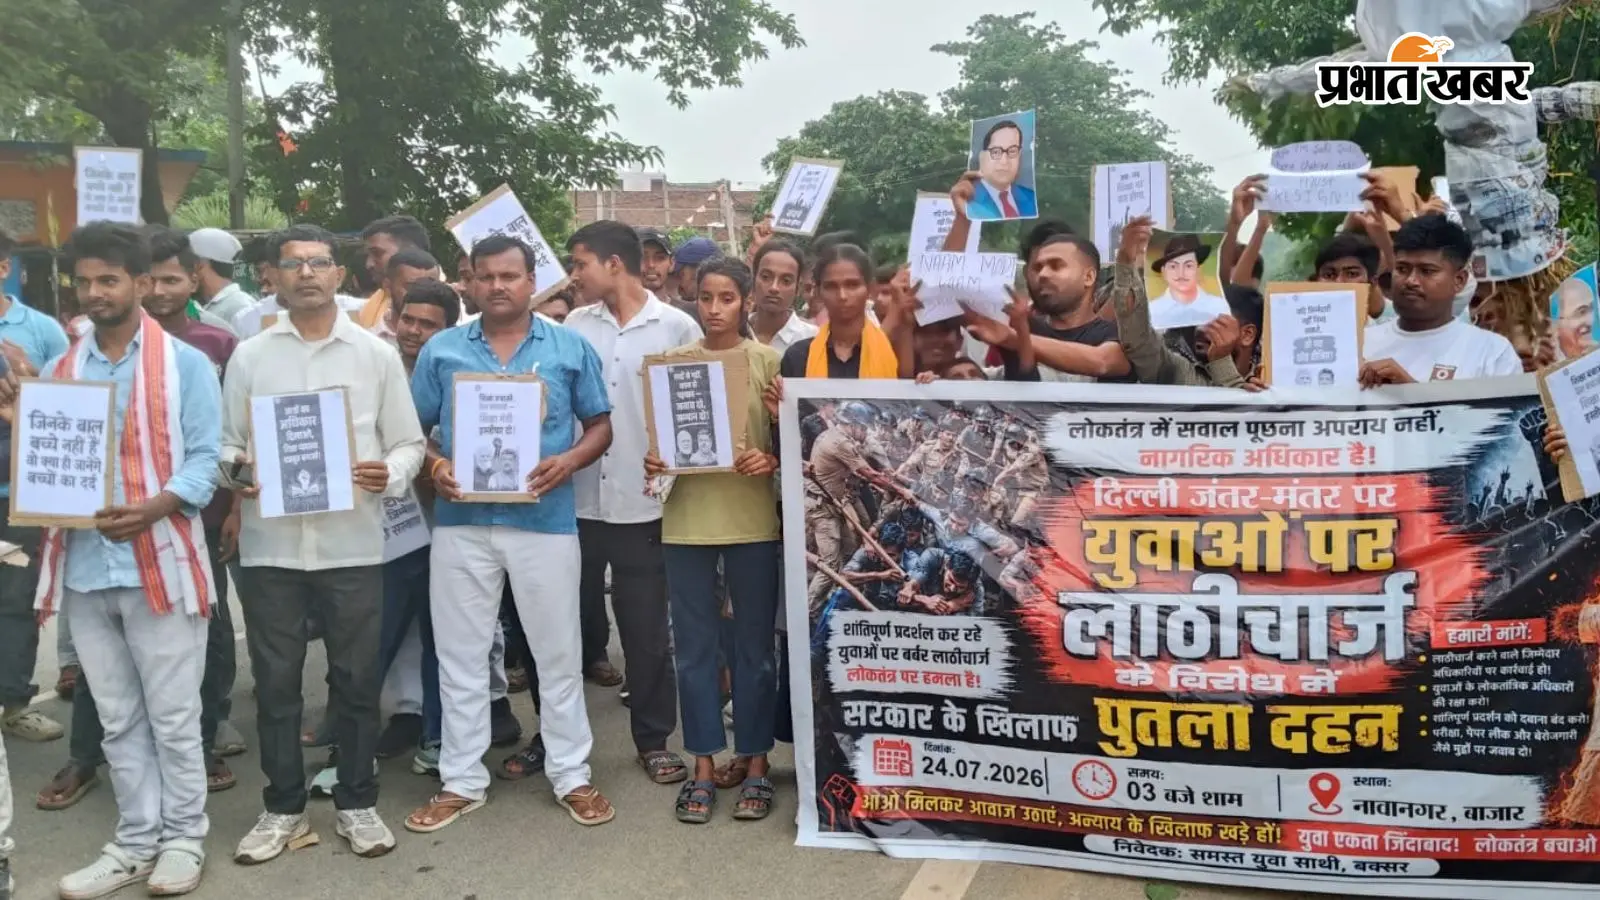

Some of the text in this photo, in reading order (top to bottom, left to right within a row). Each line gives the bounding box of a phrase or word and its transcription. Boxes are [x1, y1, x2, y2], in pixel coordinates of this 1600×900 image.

[26, 409, 104, 435] जिनके बाल
[280, 415, 317, 430] अधिकार
[1068, 417, 1144, 440] लोकतंत्र
[1150, 416, 1174, 438] में
[1176, 420, 1238, 438] सवाल
[1245, 419, 1304, 443] पूछना
[1394, 411, 1445, 434] नहीं,
[29, 433, 58, 450] बच्चे
[1138, 442, 1376, 469] नागरिक अधिकार है!
[60, 474, 76, 488] का
[80, 472, 97, 492] दर्द
[1093, 476, 1397, 510] दिल्ली जंतर-मंतर पर
[1082, 510, 1397, 589] युवाओं पर
[1058, 571, 1418, 661] लाठीचार्ज
[843, 620, 891, 641] शांतिपूर्ण
[938, 627, 960, 643] कर
[963, 623, 983, 643] रहे
[1446, 624, 1492, 645] हमारी
[838, 643, 990, 666] युवाओं पर बर्बर लाठीचार्ज
[1432, 647, 1561, 664] लाठीचार्ज करने वाले जिम्मेदार
[846, 664, 981, 688] लोकतंत्र पर हमला है!
[1115, 662, 1342, 694] के विरोध में
[1485, 667, 1497, 677] पर
[1465, 681, 1475, 692] के
[1531, 679, 1575, 693] अधिकारों
[1432, 696, 1446, 708] की
[1448, 697, 1465, 708] रक्षा
[841, 700, 1079, 743] सरकार के खिलाफ
[1093, 697, 1403, 758] पुतला दहन
[1504, 711, 1517, 723] को
[1520, 714, 1548, 725] दबाना
[1550, 713, 1565, 725] बंद
[1466, 725, 1486, 738] पेपर
[1488, 726, 1511, 740] लीक
[1514, 728, 1532, 741] और
[1473, 745, 1486, 756] पर
[1488, 746, 1516, 757] जवाब
[922, 756, 1044, 788] 24.07.2026
[1127, 766, 1165, 781] समय:
[1352, 774, 1391, 788] स्थान:
[1126, 781, 1243, 808] 03 बजे शाम
[904, 789, 964, 814] मिलकर
[969, 799, 1017, 820] आवाज
[1022, 805, 1062, 828] उठाएं,
[1069, 812, 1122, 834] अन्याय
[1128, 810, 1143, 836] के
[1150, 814, 1213, 843] खिलाफ
[1219, 823, 1250, 847] खड़े
[1254, 821, 1282, 845] हों!
[1464, 804, 1525, 822] बाजार
[1297, 828, 1598, 854] युवा एकता जिंदाबाद! लोकतंत्र बचाओ
[1113, 837, 1409, 875] निवेदक: समस्त युवा साथी, बक्सर
